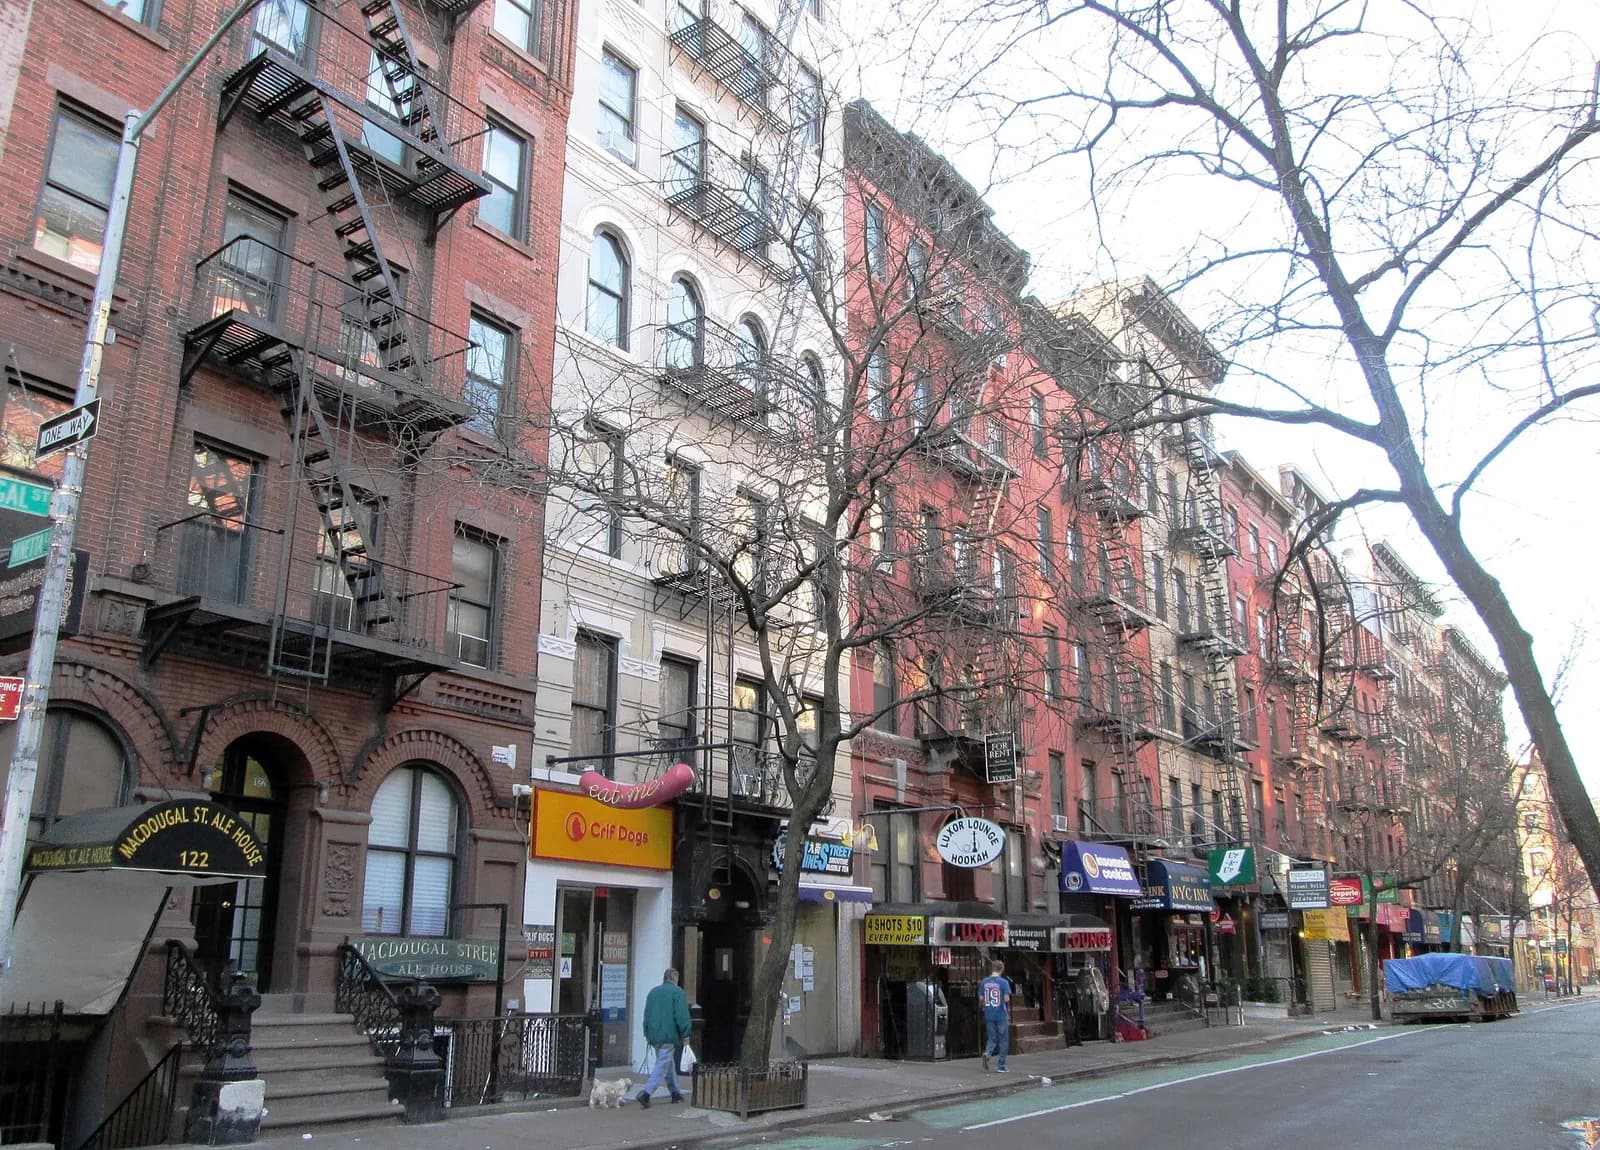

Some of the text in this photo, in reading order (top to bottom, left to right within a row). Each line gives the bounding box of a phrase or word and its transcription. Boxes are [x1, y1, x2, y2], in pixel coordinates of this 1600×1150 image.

[45, 415, 89, 444] ONE WAY
[989, 749, 1011, 758] RENT
[991, 742, 1008, 750] FOR
[589, 781, 660, 804] eat me
[118, 806, 263, 867] MACDOUGAL ST. ALE HOUSE
[591, 822, 649, 846] Crif Dogs
[940, 819, 1000, 848] LUXOR LOUNGE
[78, 848, 91, 865] ALE
[92, 846, 113, 864] HOUSE
[180, 850, 209, 867] 122
[951, 850, 989, 865] HOOKAH
[1102, 868, 1133, 880] cookies
[1172, 885, 1209, 901] NYC INK
[868, 919, 922, 931] 4 SHOTS $10
[952, 922, 1006, 943] LUXOR
[869, 934, 895, 942] EVERY
[1008, 929, 1047, 938] estaurant
[1064, 932, 1112, 948] LOUNGE
[1012, 938, 1040, 949] Lounge
[457, 943, 499, 965] STREE
[399, 964, 473, 975] ALE HOUSE
[562, 960, 570, 973] A
[984, 987, 1000, 1007] 19
